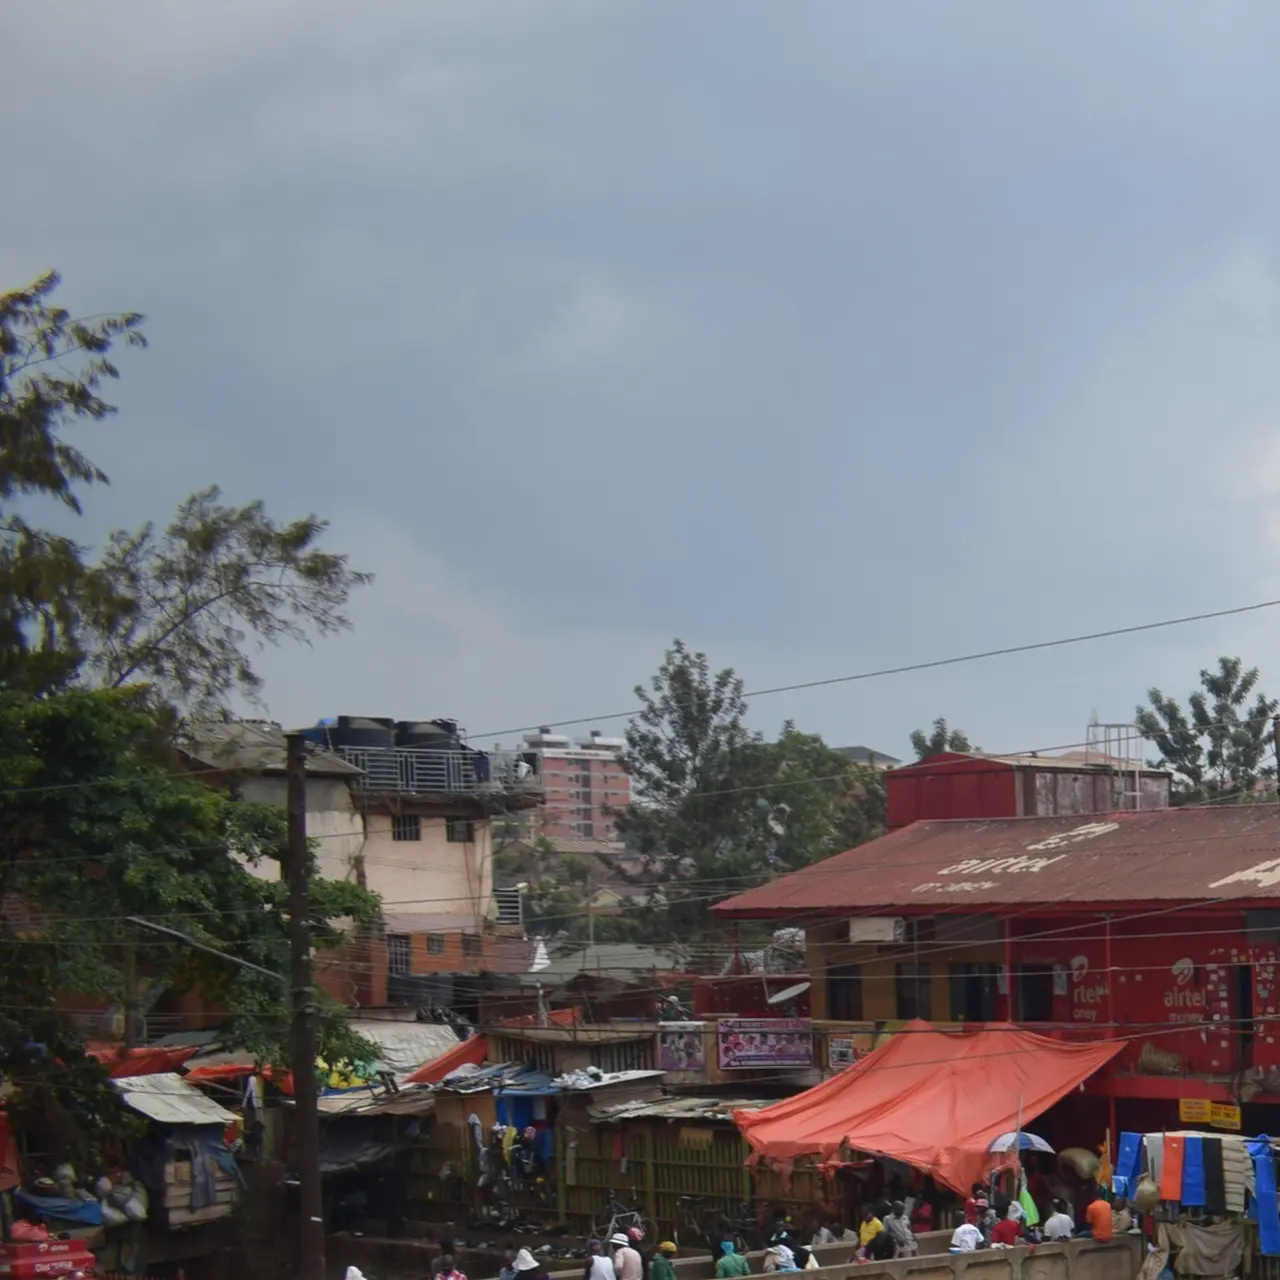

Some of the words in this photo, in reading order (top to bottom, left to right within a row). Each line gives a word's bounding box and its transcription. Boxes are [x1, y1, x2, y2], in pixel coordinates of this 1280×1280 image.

[1073, 985, 1102, 1004] rtel
[1164, 990, 1206, 1007] airtel
[1072, 1009, 1097, 1021] oney
